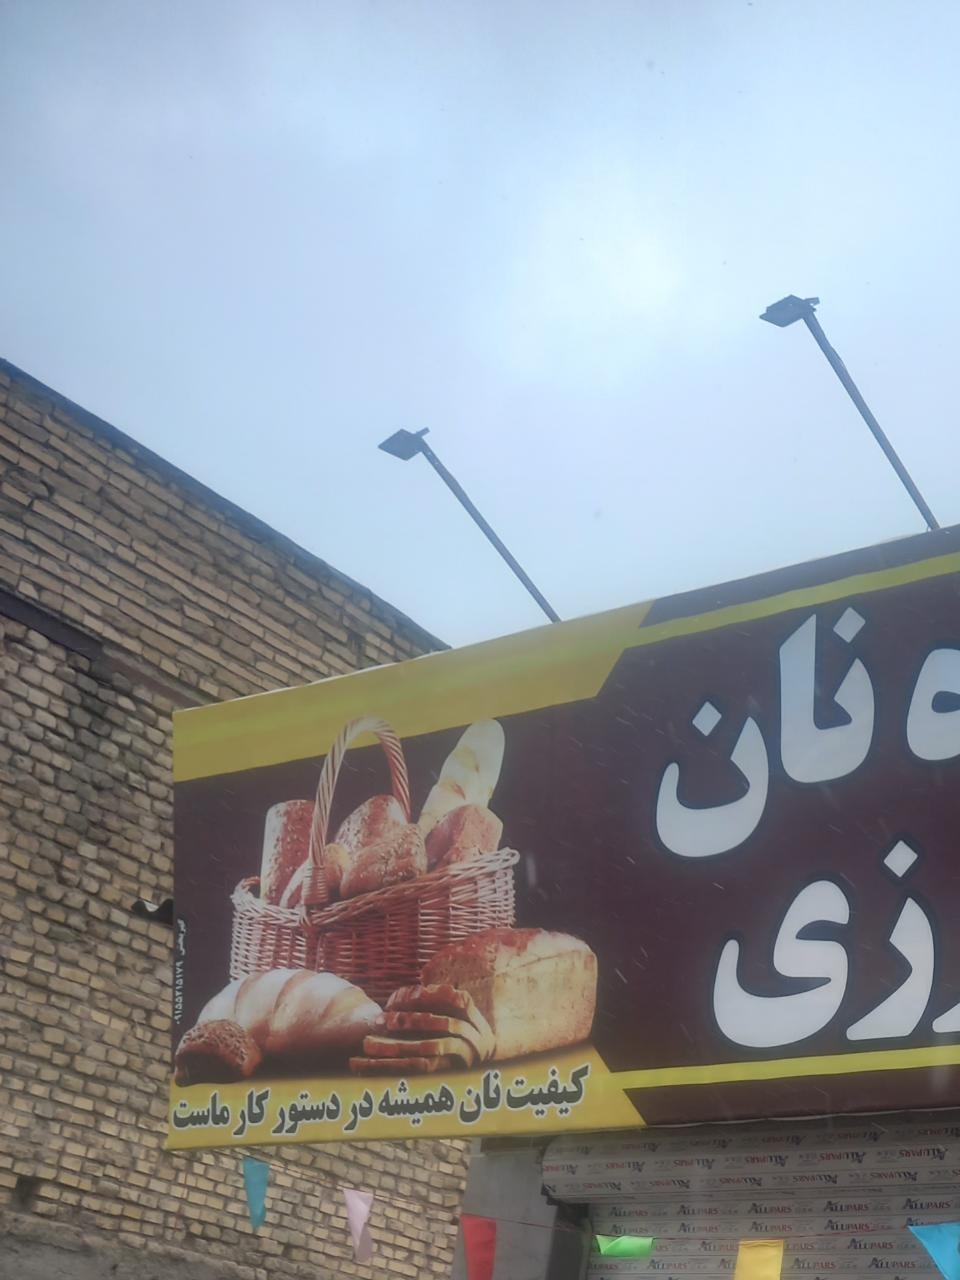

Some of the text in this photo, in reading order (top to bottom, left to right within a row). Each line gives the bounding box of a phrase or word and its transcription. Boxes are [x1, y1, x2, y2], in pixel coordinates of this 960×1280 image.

[655, 607, 876, 858] نان
[172, 1065, 590, 1136] کیفیت نان همیشه در دستور کار ماست
